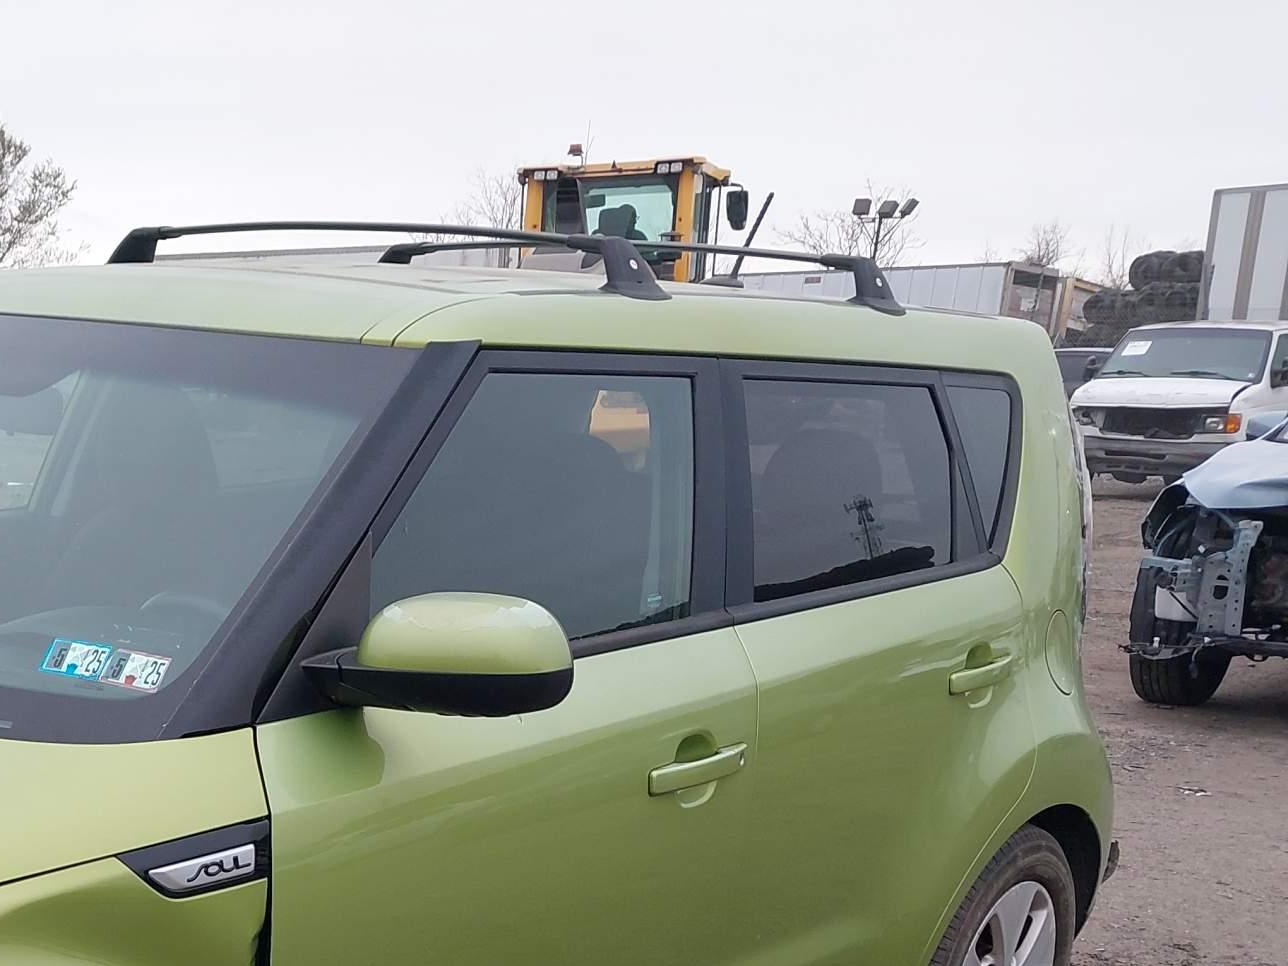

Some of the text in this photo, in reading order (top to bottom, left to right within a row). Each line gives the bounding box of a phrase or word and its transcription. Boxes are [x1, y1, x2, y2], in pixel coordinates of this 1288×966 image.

[84, 649, 106, 674] 25
[143, 660, 166, 686] 25
[186, 855, 252, 883] SOUL
